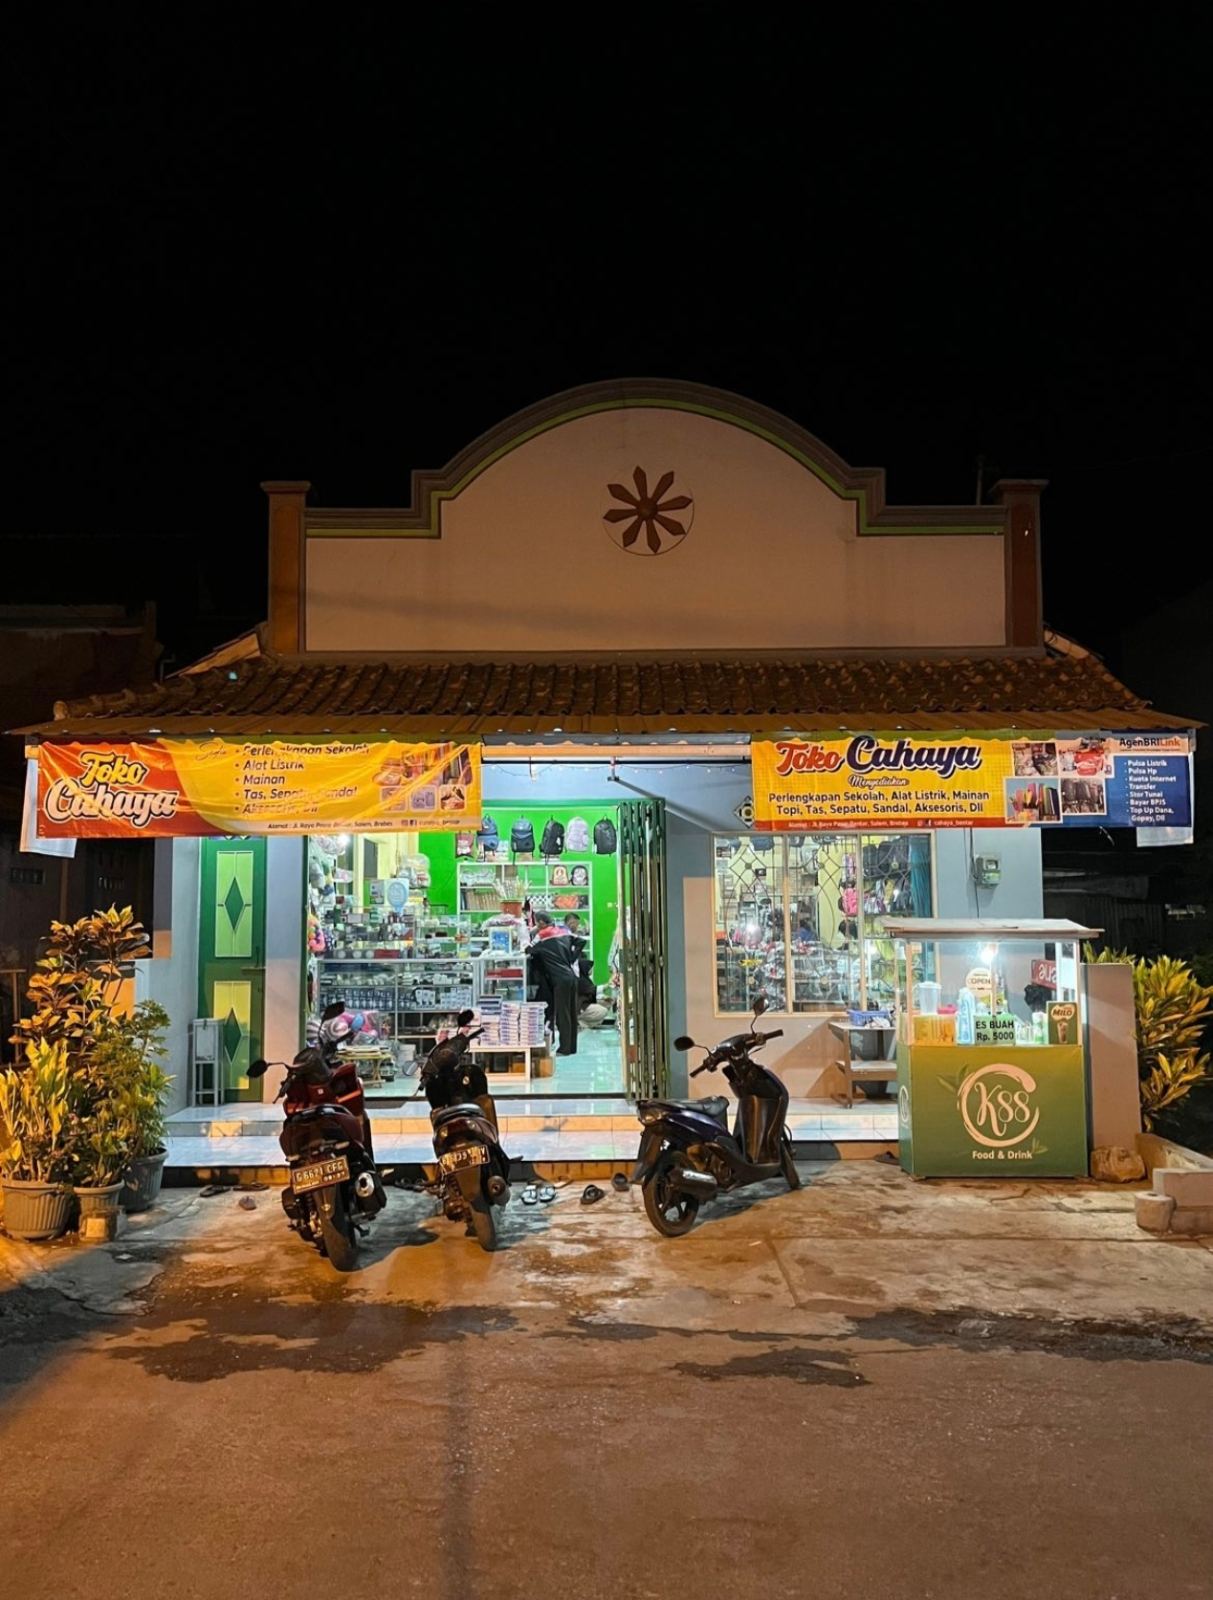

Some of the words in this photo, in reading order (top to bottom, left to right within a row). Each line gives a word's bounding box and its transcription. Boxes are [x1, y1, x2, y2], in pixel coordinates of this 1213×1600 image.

[1119, 737, 1181, 748] AgenBRILink
[776, 741, 844, 776] Toko
[846, 735, 982, 779] Cahaya
[79, 751, 149, 788] Toko
[243, 760, 268, 770] Alat
[243, 774, 285, 785] Mainan
[768, 793, 841, 804] Perlengkapan
[844, 791, 888, 801] Sekolah,
[891, 790, 912, 800] Alat
[915, 790, 950, 801] Listrik,
[953, 790, 989, 800] Mainan
[45, 778, 179, 828] Cahaya
[777, 805, 803, 816] Topi,
[806, 805, 827, 815] Tas,
[830, 804, 870, 815] Sepatu,
[873, 803, 911, 814] Sandal,
[915, 802, 967, 813] Aksesoris,
[970, 803, 983, 812] Dll
[1052, 1008, 1073, 1017] MILO
[975, 1020, 987, 1029] ES
[989, 1020, 1014, 1029] BUAH
[976, 1032, 990, 1042] Rp.
[992, 1031, 1014, 1041] 5000
[972, 1150, 995, 1159] Food
[997, 1150, 1005, 1159] &
[1007, 1150, 1033, 1159] Drink
